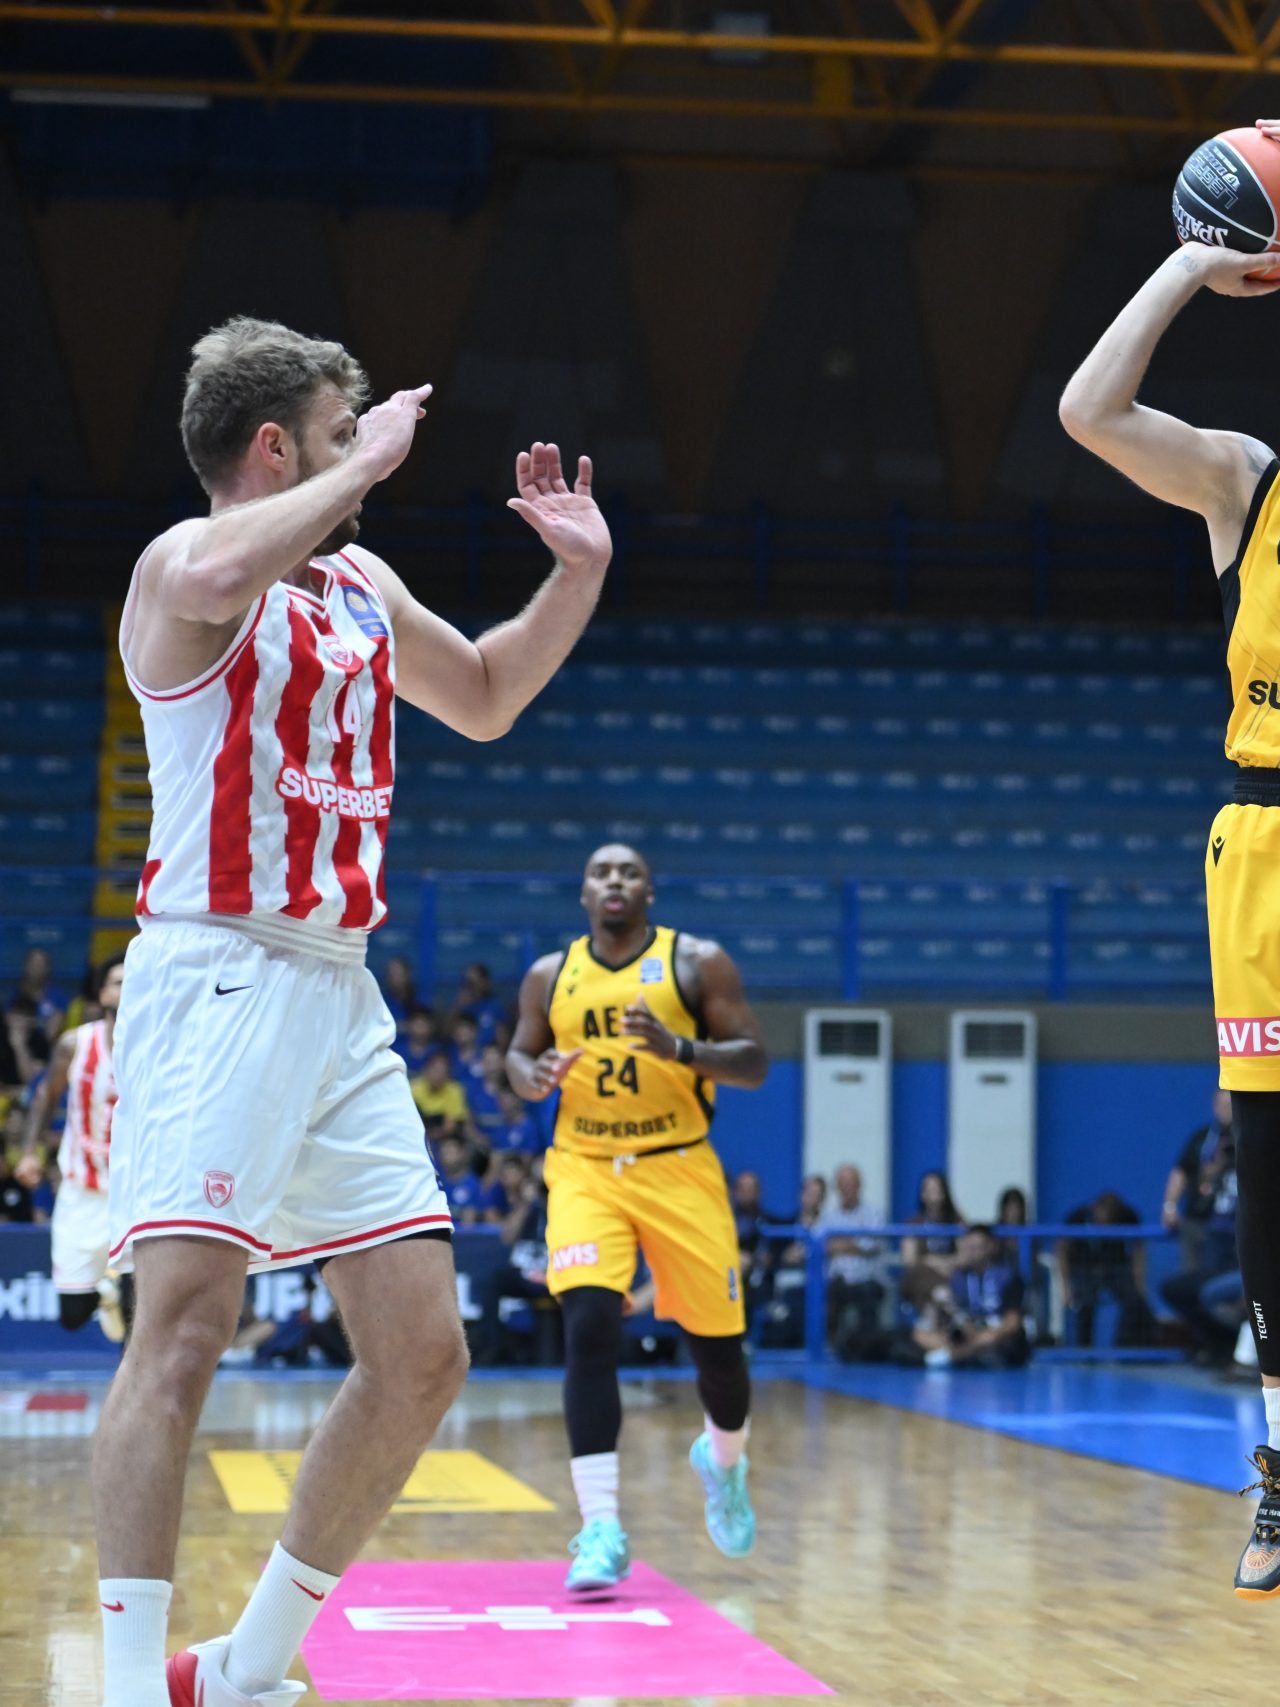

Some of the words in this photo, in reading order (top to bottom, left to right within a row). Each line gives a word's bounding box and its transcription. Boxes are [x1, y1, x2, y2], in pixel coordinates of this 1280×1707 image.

[583, 1006, 632, 1039] AE
[597, 1056, 639, 1098] 24
[574, 1113, 678, 1139] SUPERBET
[1253, 1301, 1268, 1340] TECHFIT
